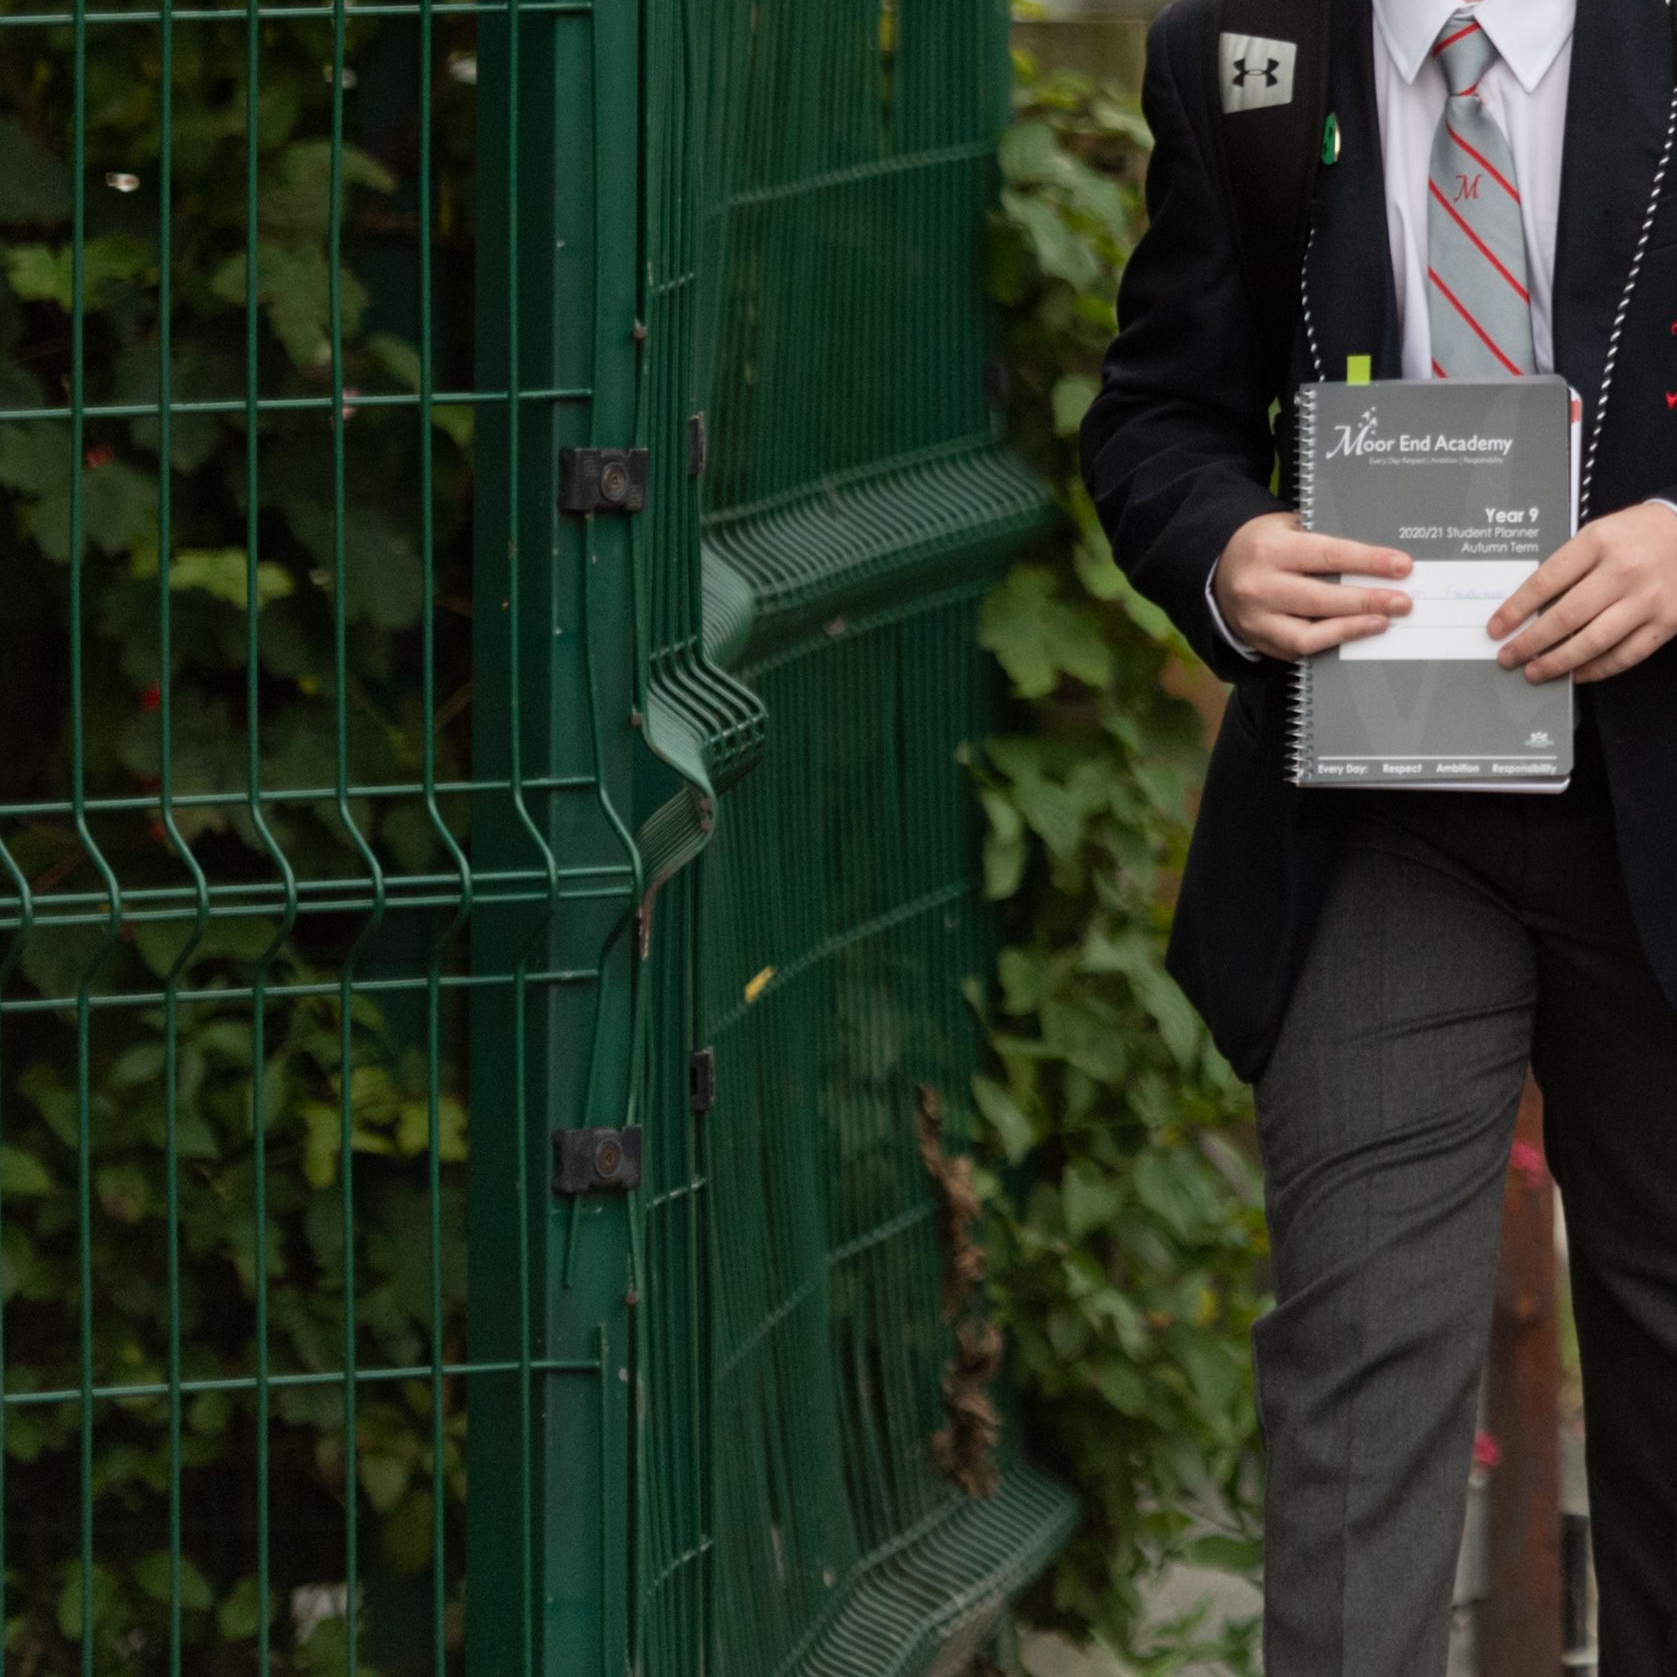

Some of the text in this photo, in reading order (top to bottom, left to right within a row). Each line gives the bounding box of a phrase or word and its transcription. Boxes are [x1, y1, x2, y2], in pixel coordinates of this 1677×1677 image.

[1325, 423, 1514, 460] Moor End Academy
[1484, 506, 1540, 524] Year 9
[1398, 526, 1540, 540] 2020/21 Student Planner
[1460, 541, 1540, 554] Autumn Term
[1317, 762, 1557, 775] Every Day: Respect Ambition Responsibility
